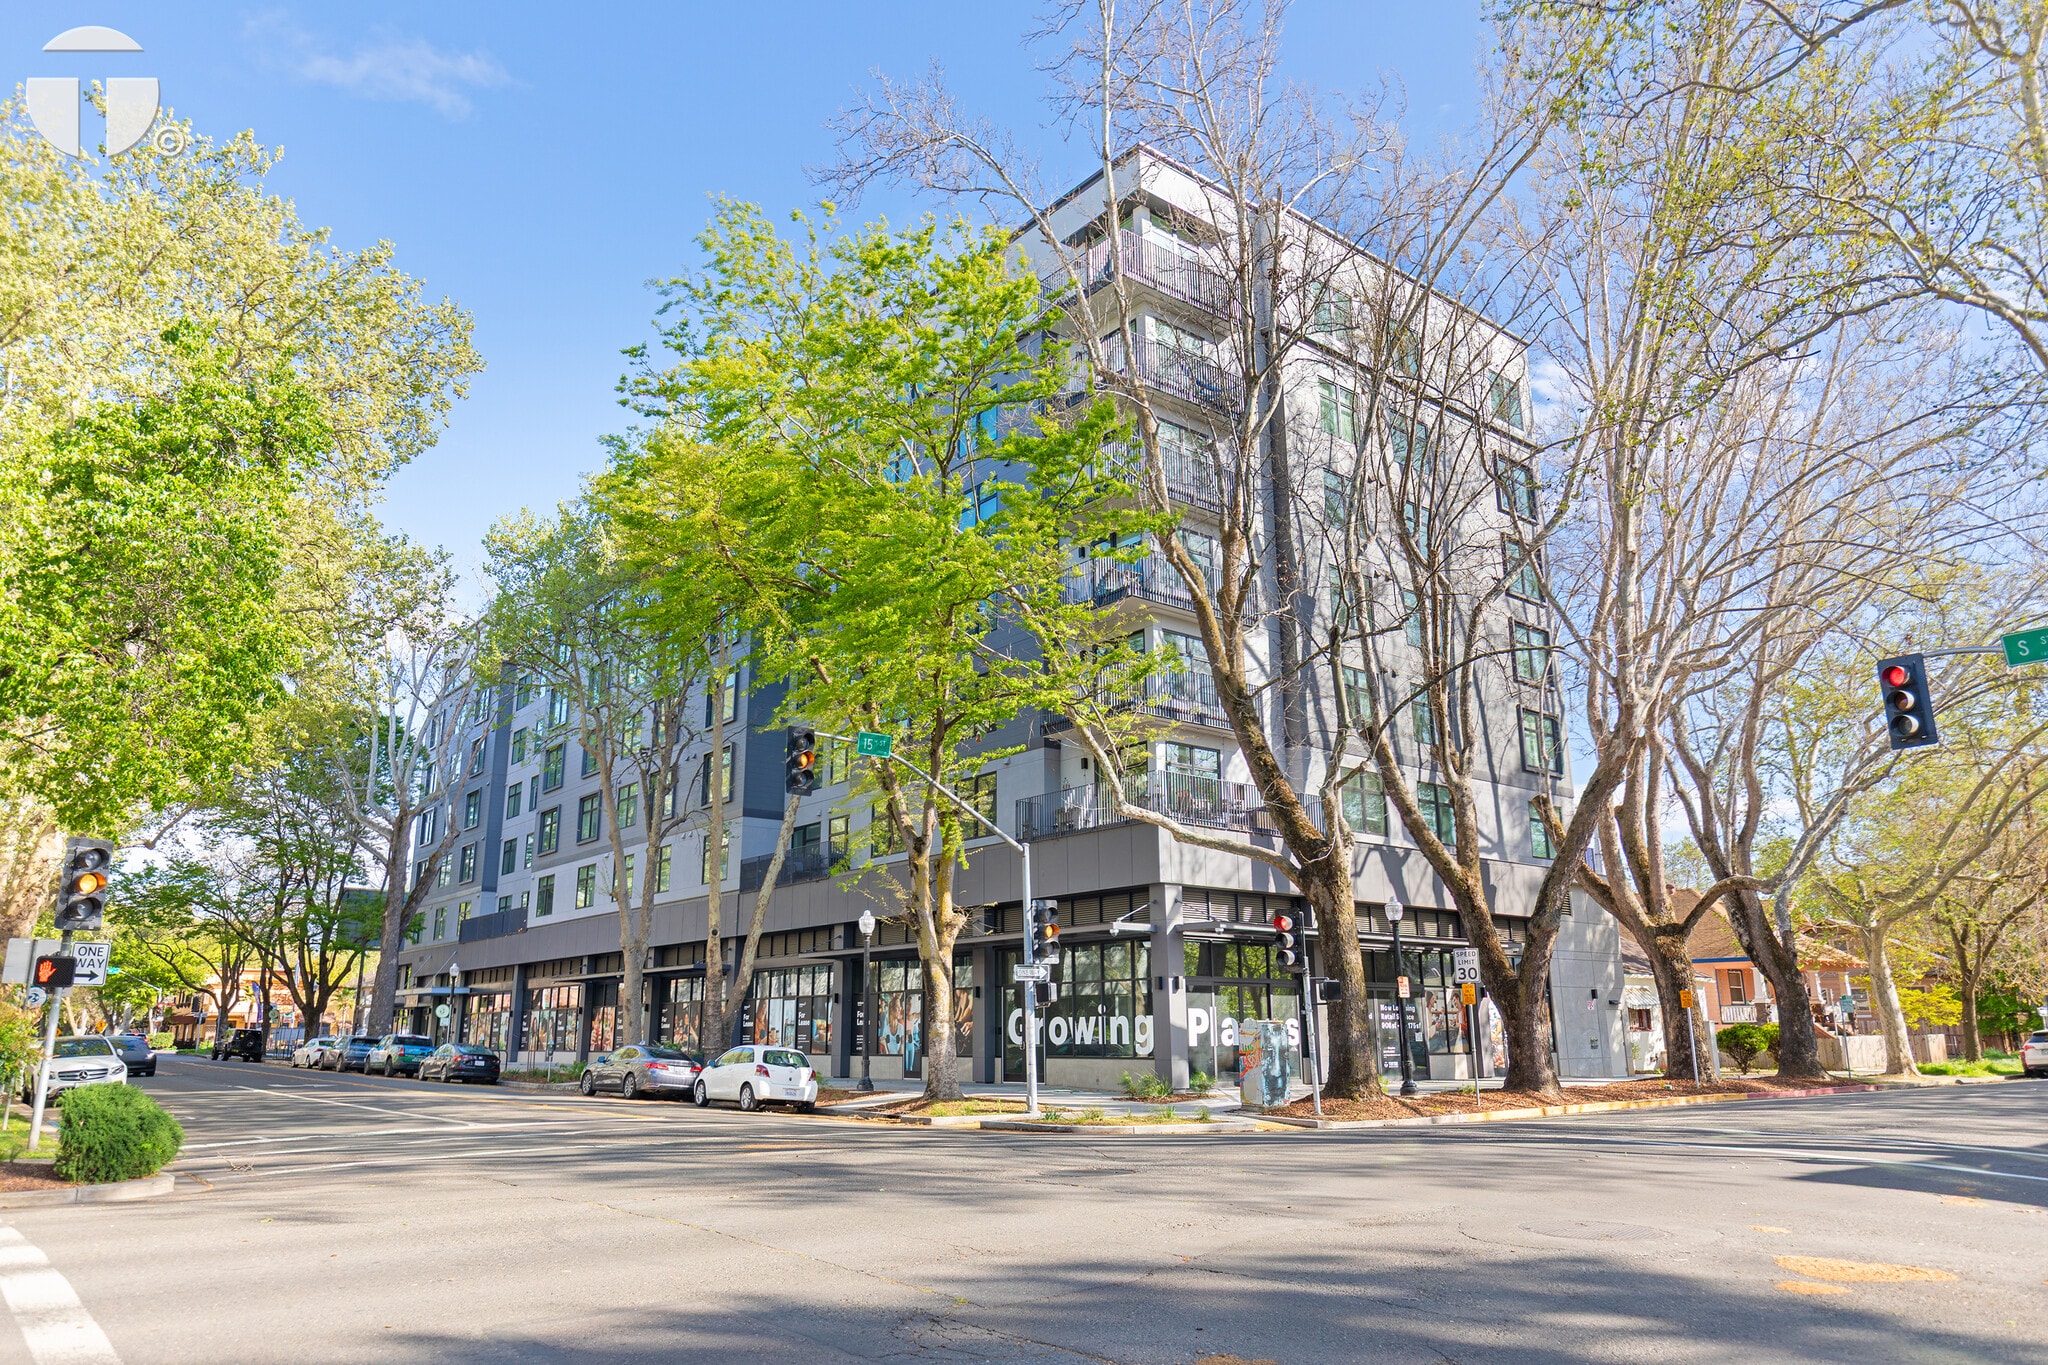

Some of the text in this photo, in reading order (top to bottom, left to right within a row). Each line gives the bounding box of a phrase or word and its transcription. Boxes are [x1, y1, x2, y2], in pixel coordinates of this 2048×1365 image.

[2017, 639, 2030, 656] S
[78, 946, 104, 957] ONE
[76, 958, 105, 969] WAY
[1458, 967, 1478, 980] 30
[1187, 1006, 1299, 1047] Plas
